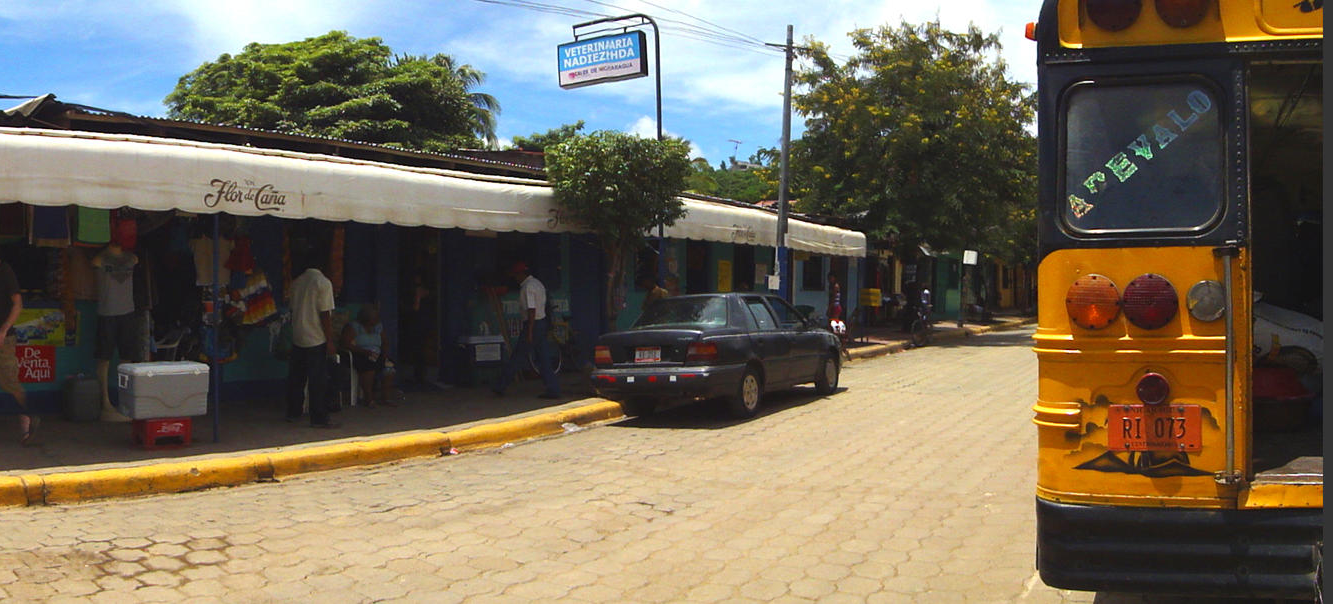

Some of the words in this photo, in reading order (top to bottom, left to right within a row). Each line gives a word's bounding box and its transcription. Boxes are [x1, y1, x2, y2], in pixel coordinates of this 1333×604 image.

[204, 178, 243, 208] Flor
[244, 188, 254, 201] de
[254, 184, 286, 211] Caña
[24, 347, 41, 359] De
[17, 358, 50, 368] Venta
[1122, 416, 1141, 439] RI
[1154, 416, 1186, 439] 073
